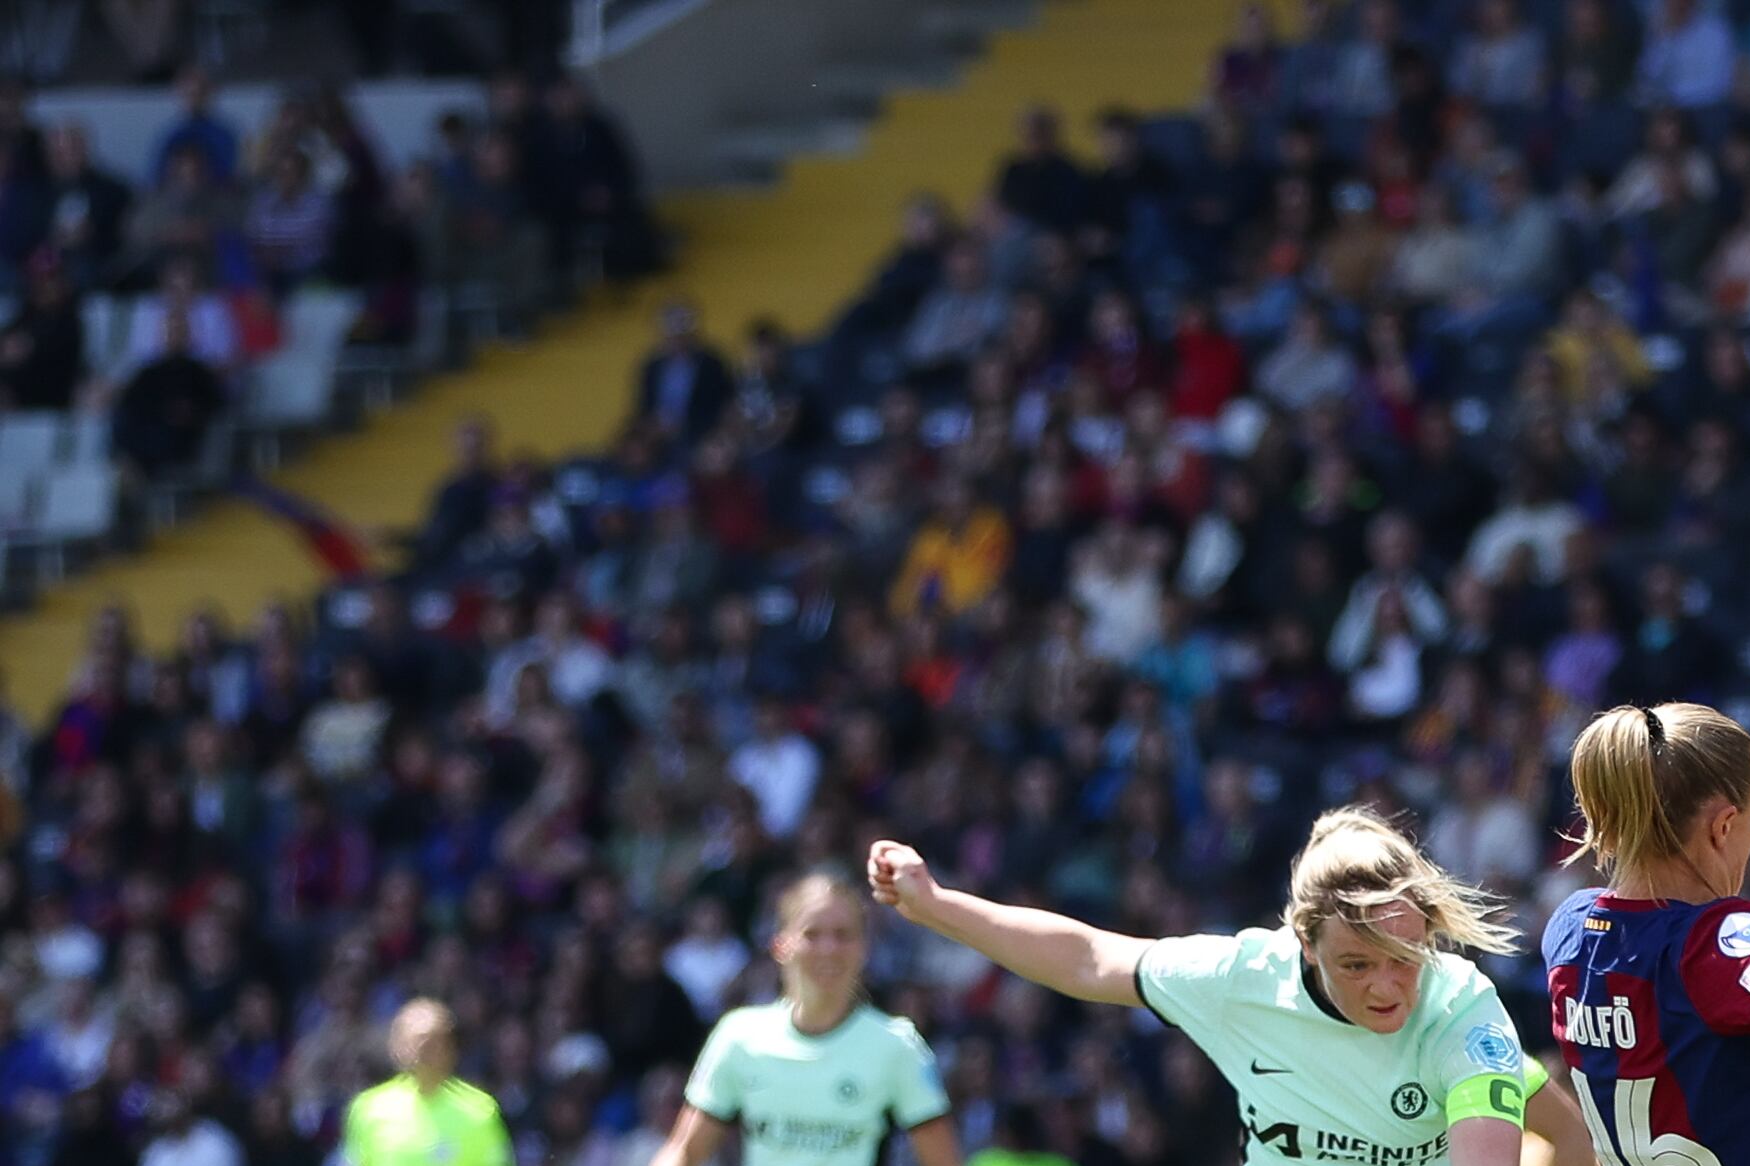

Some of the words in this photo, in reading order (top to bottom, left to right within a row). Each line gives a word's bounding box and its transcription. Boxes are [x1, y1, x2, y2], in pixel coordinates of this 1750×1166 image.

[1565, 995, 1637, 1049] ROLFÖ
[1488, 1078, 1523, 1120] C
[1317, 1130, 1449, 1160] INFINITE
